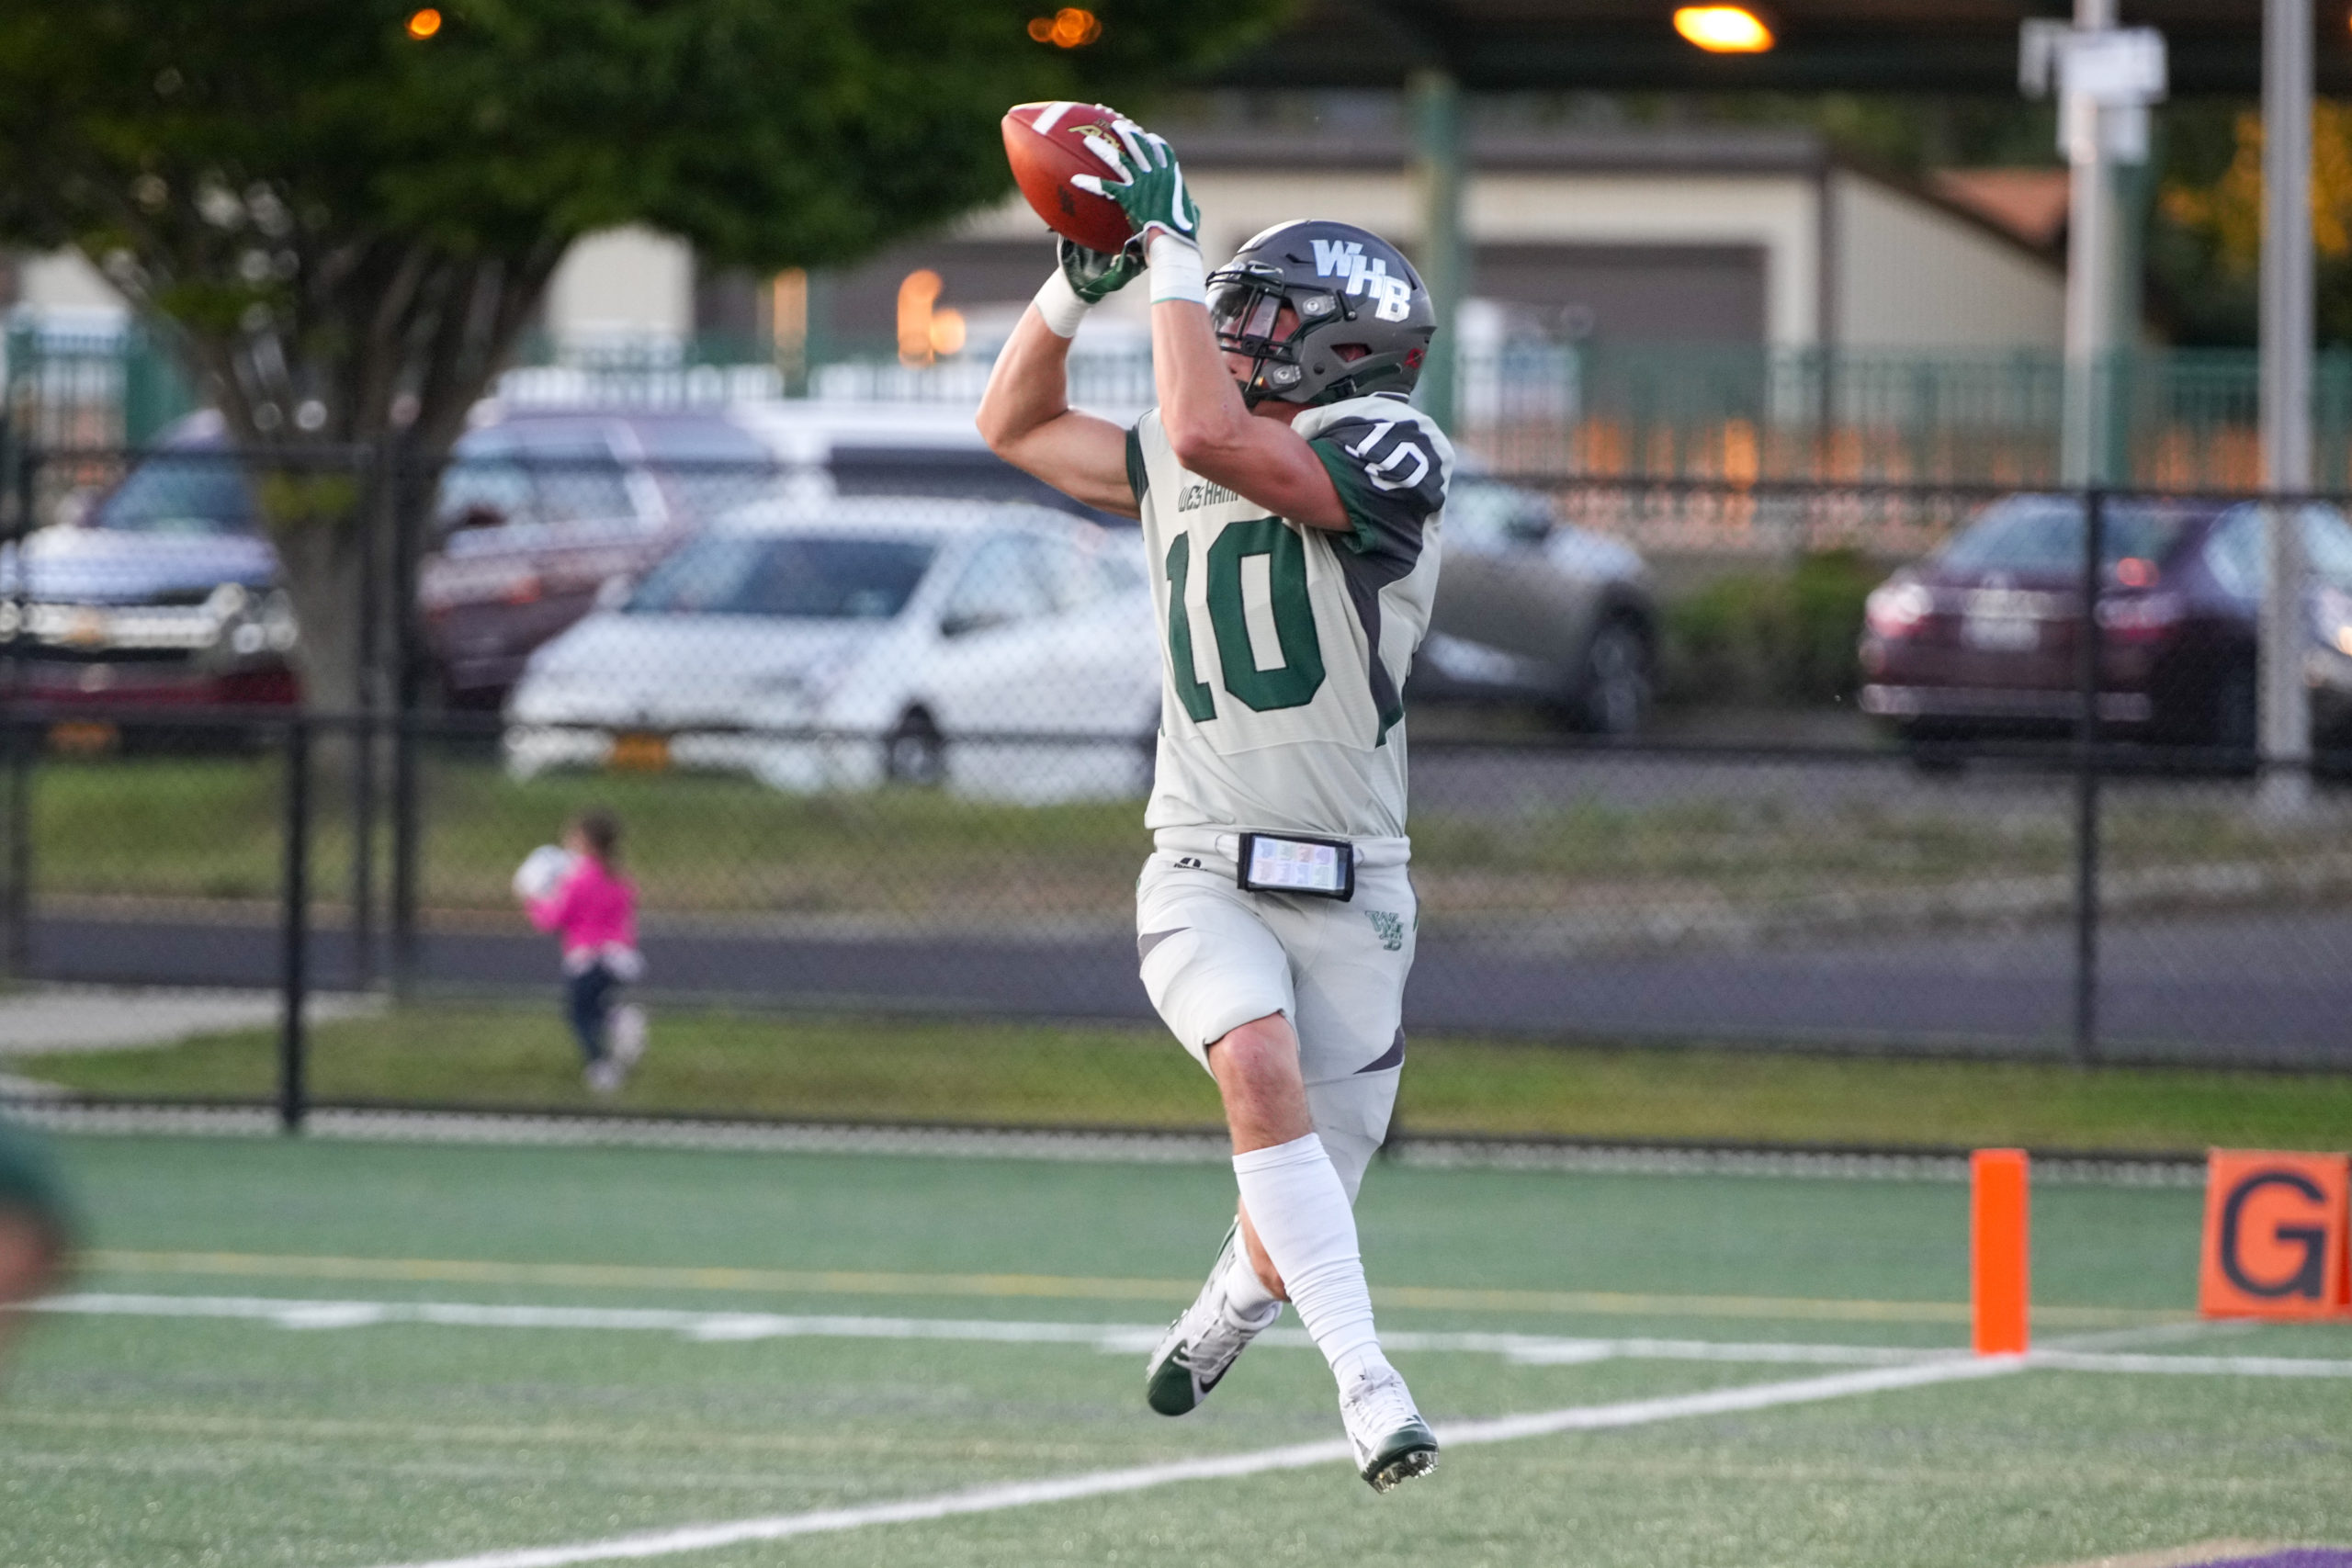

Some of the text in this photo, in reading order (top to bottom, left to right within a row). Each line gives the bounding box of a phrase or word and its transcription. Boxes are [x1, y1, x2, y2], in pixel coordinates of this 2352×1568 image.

[1309, 240, 1410, 322] WHB
[1344, 422, 1430, 491] 10
[1166, 515, 1326, 723] 10
[2220, 1169, 2329, 1302] G
